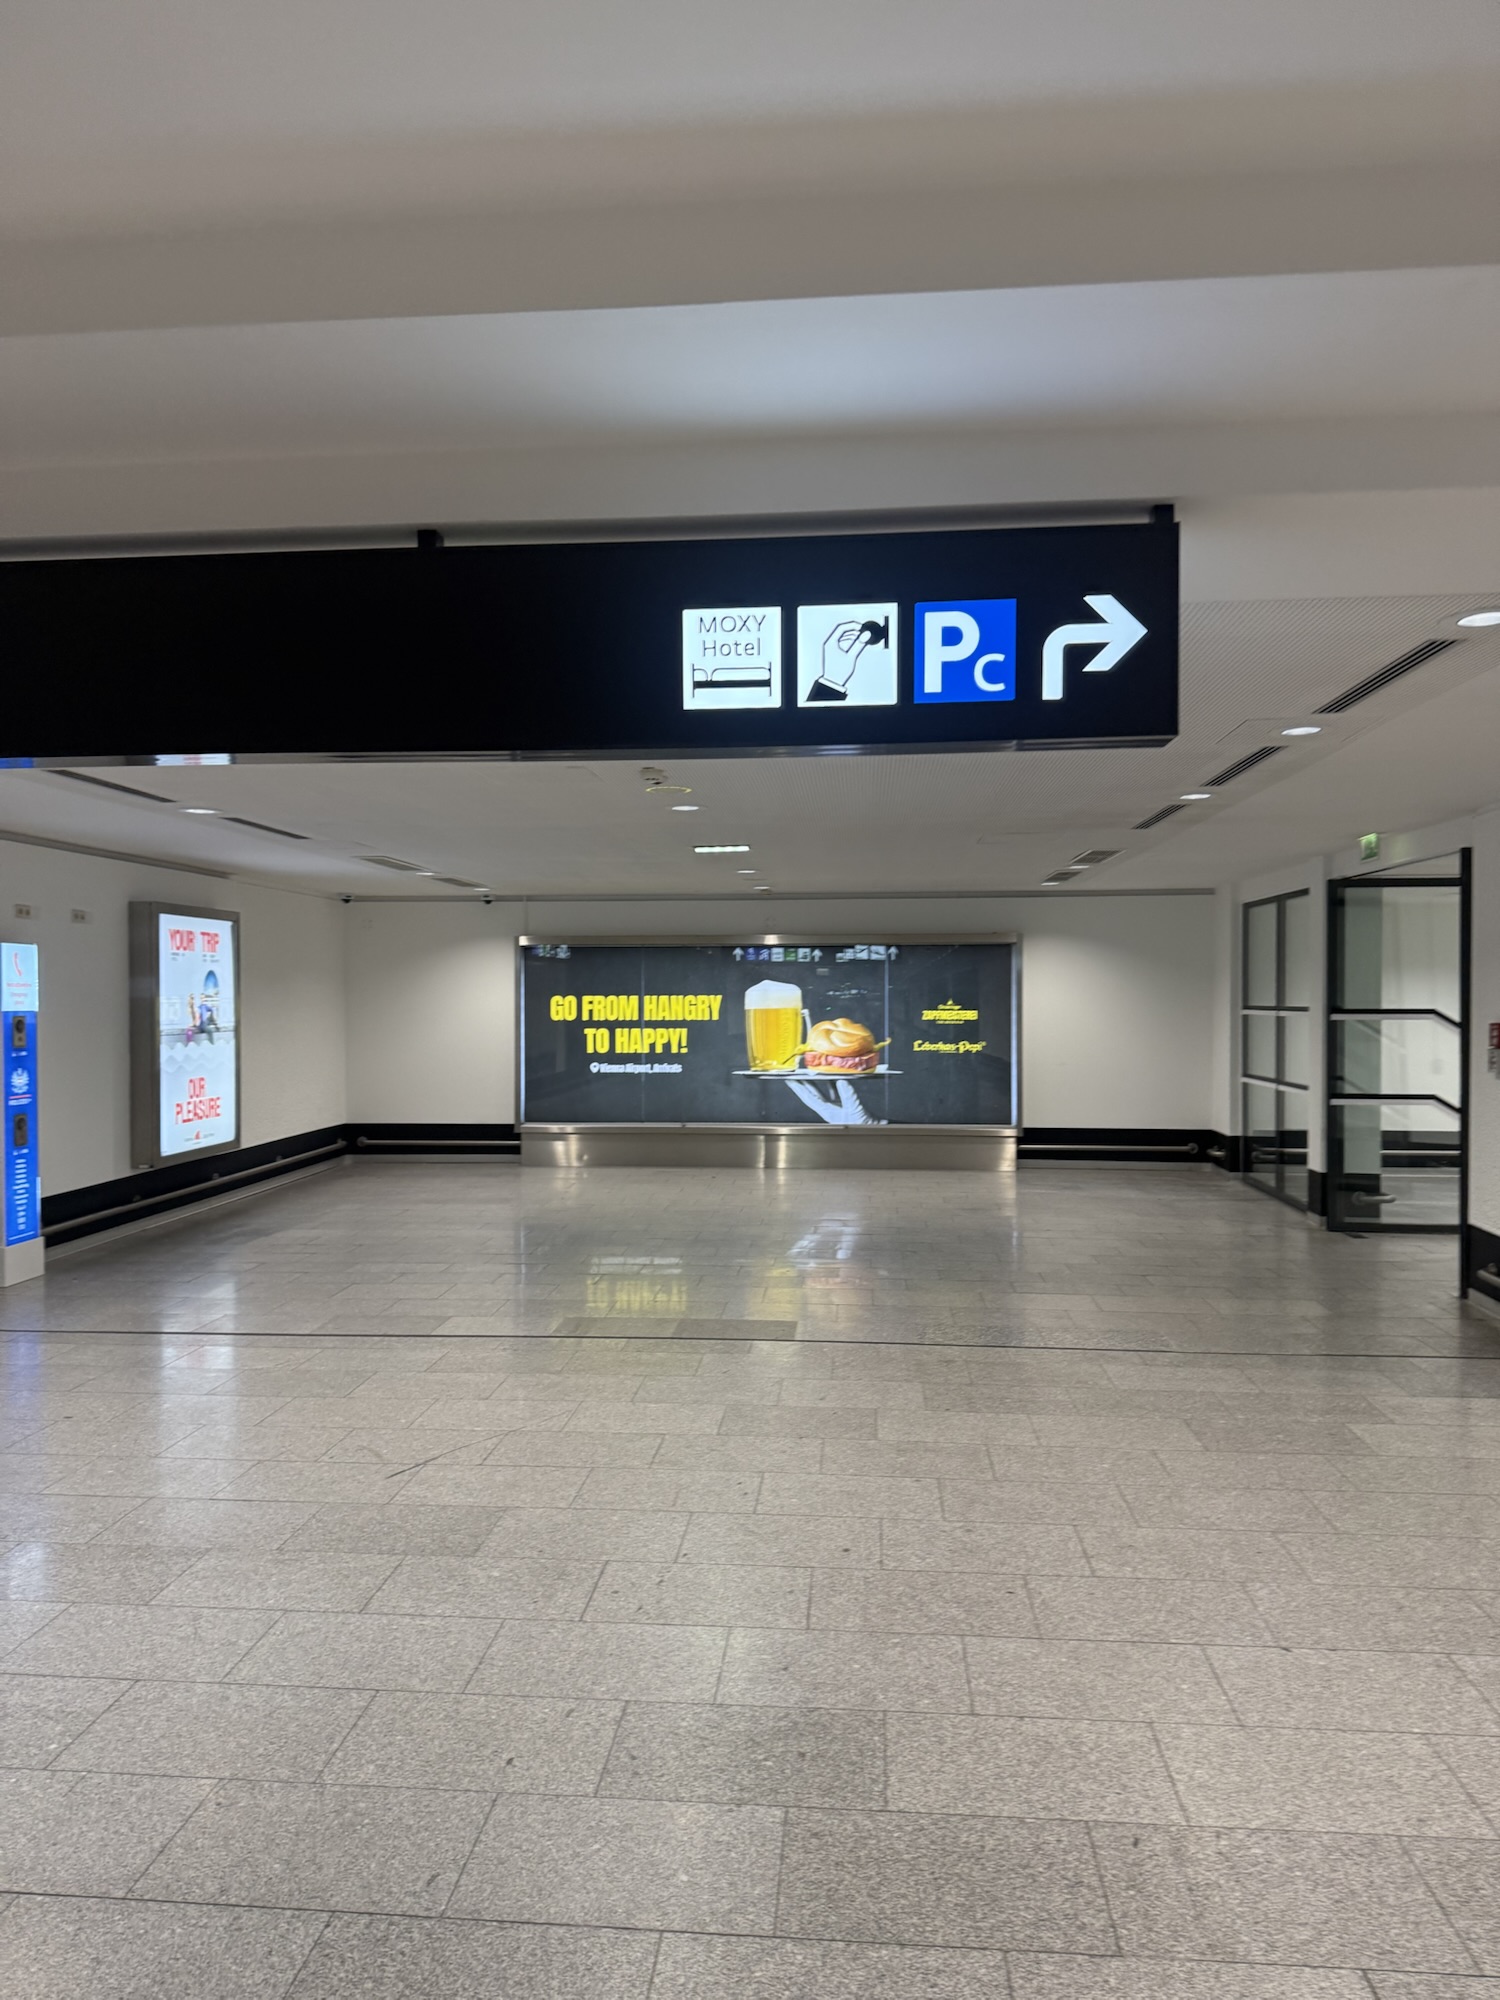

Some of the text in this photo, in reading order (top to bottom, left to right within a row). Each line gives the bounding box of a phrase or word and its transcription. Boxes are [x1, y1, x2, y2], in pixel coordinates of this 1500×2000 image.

[699, 614, 766, 634] MOXY
[702, 637, 761, 657] Hotel
[168, 928, 220, 953] YOUR TRIP
[550, 994, 723, 1021] GO FROM HANGRY
[583, 1027, 689, 1054] TO HAPPY!
[188, 1077, 206, 1099] OUR
[175, 1096, 222, 1125] PLEASURE
